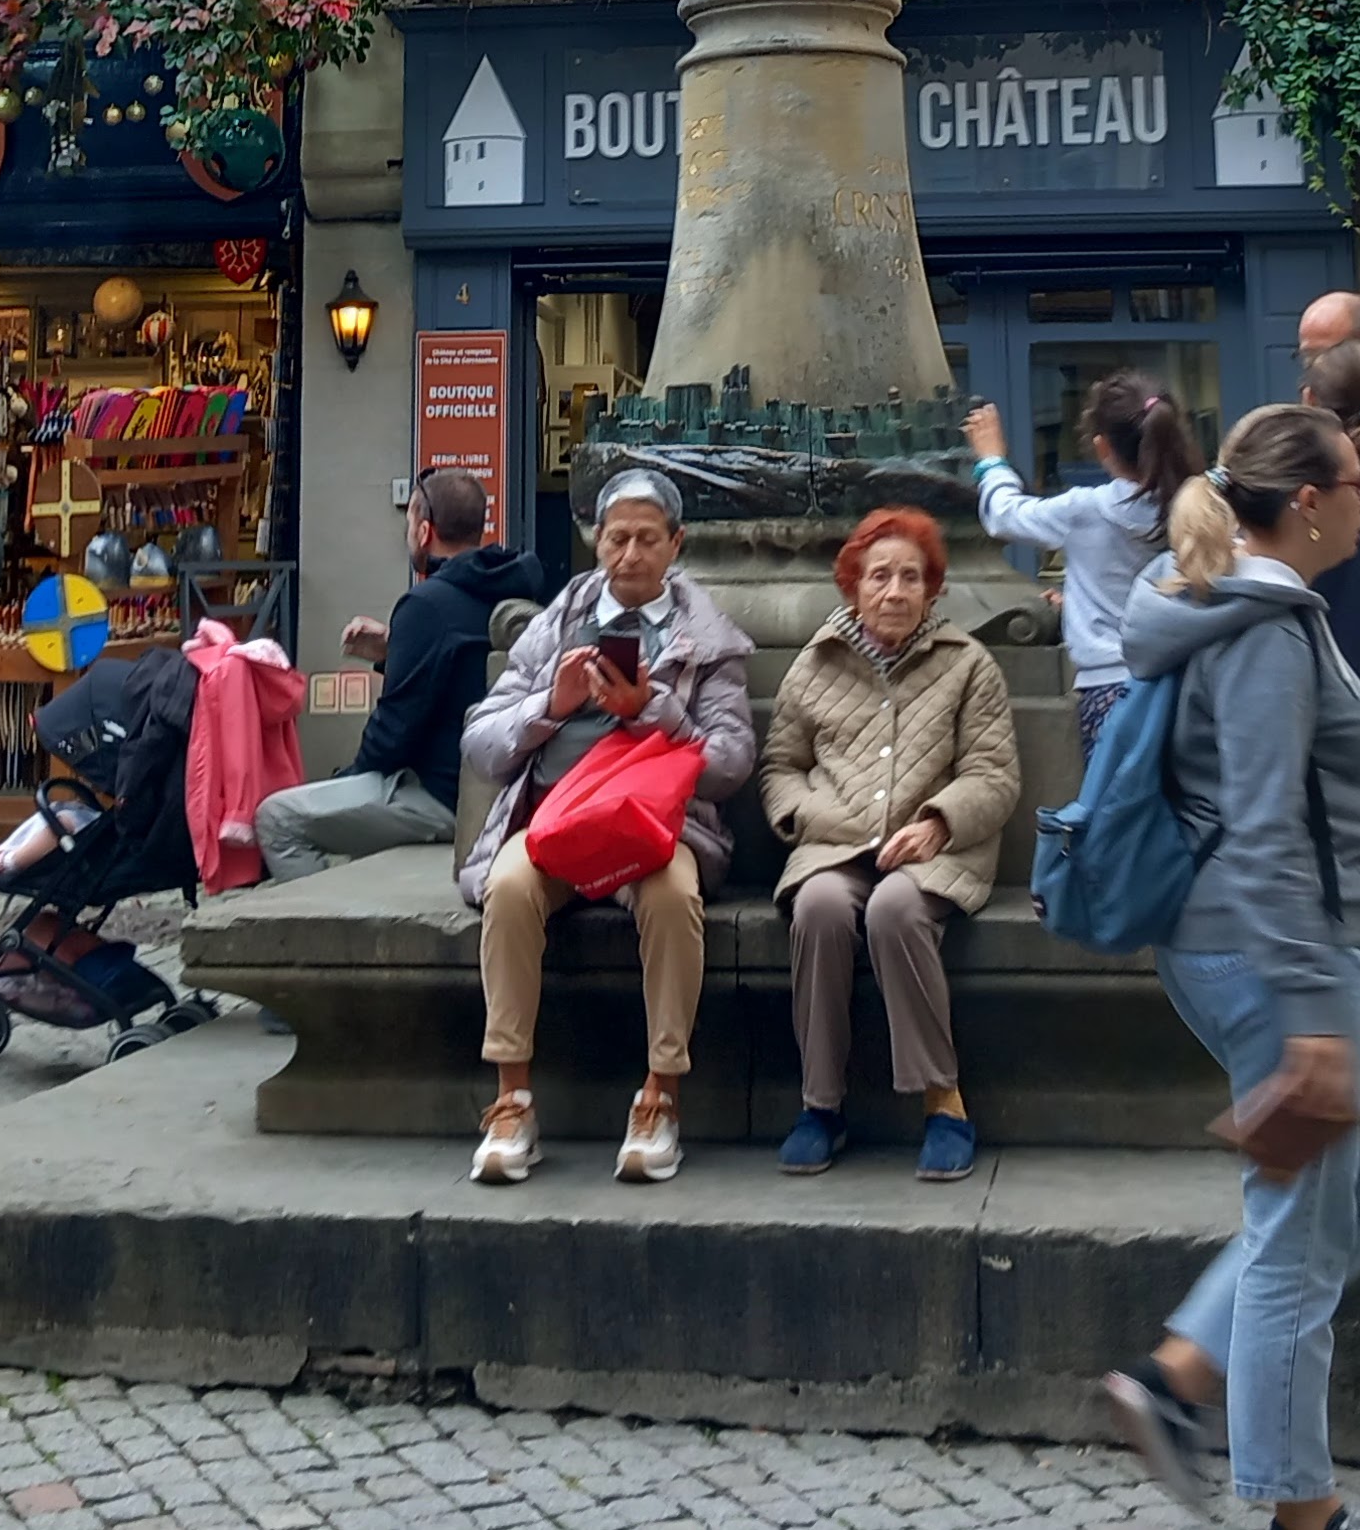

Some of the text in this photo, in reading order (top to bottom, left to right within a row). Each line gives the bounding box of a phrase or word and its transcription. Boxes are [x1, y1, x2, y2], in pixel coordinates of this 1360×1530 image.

[564, 90, 685, 160] BOUT
[918, 66, 1168, 149] CHÂTEAU
[455, 282, 469, 305] 4
[428, 385, 494, 402] BOUTIQUE
[425, 403, 497, 419] OFFICIELLE
